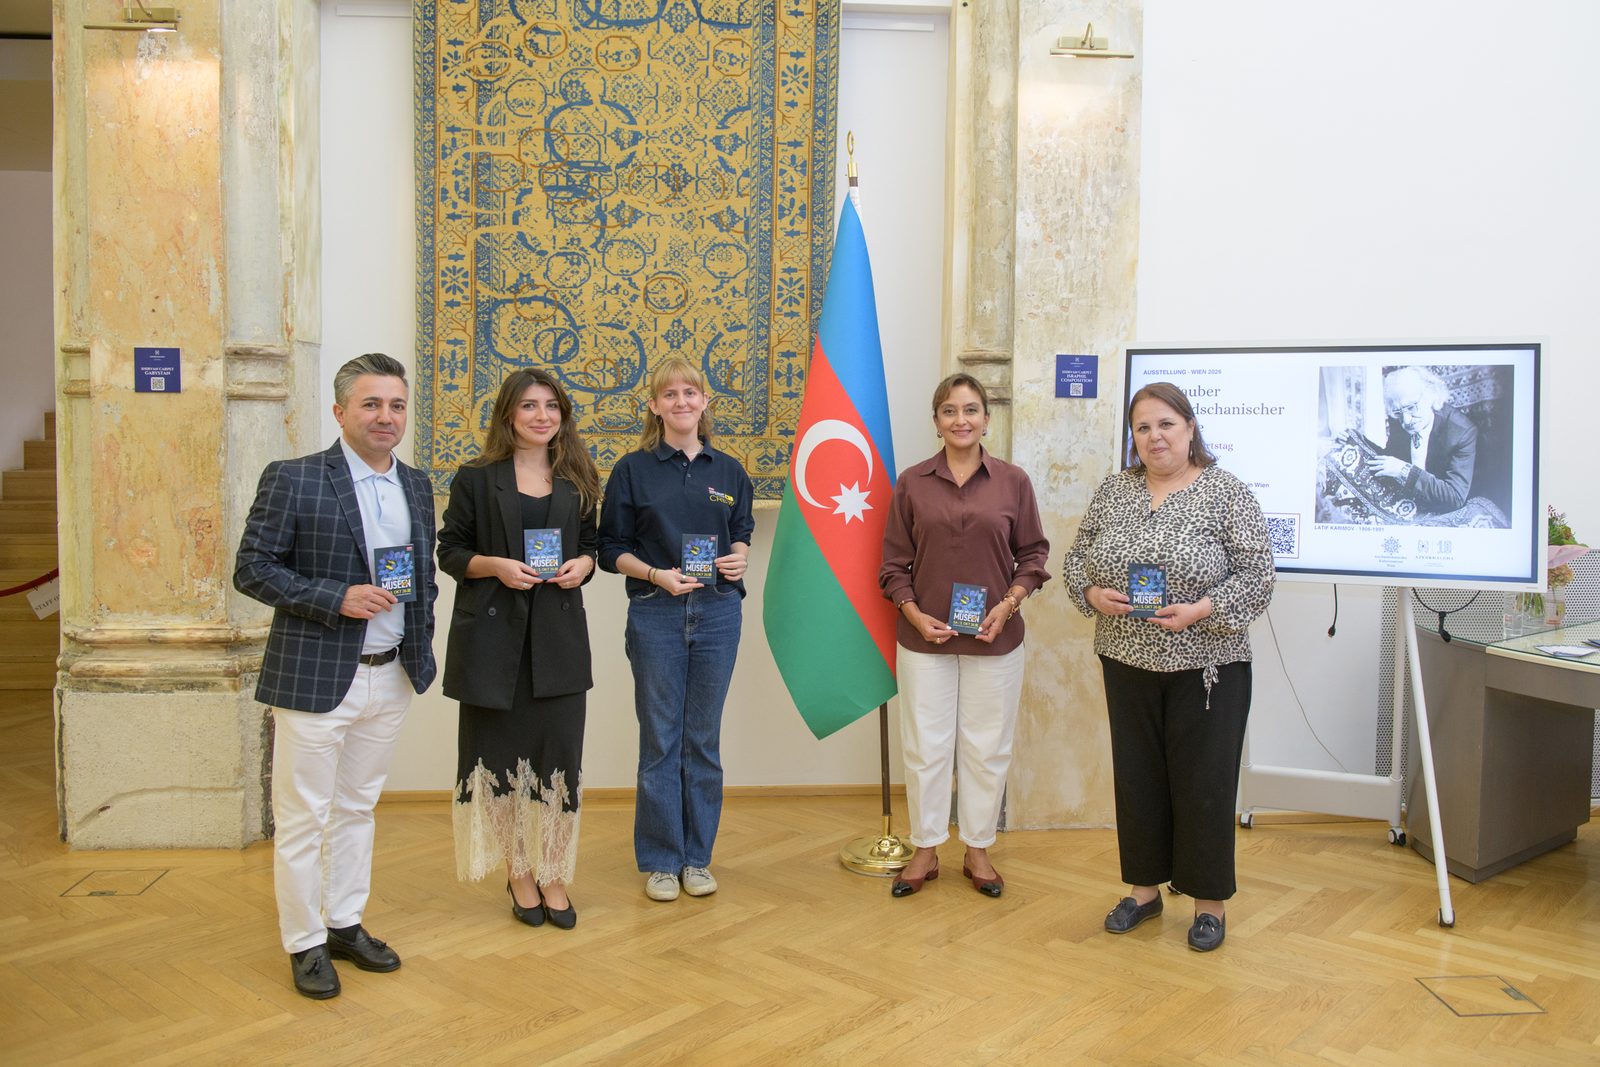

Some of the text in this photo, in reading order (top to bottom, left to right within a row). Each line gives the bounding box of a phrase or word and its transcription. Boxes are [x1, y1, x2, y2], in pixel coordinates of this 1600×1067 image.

[1178, 385, 1221, 397] auber
[1192, 403, 1285, 415] dschanischer
[1205, 442, 1234, 451] rtstag
